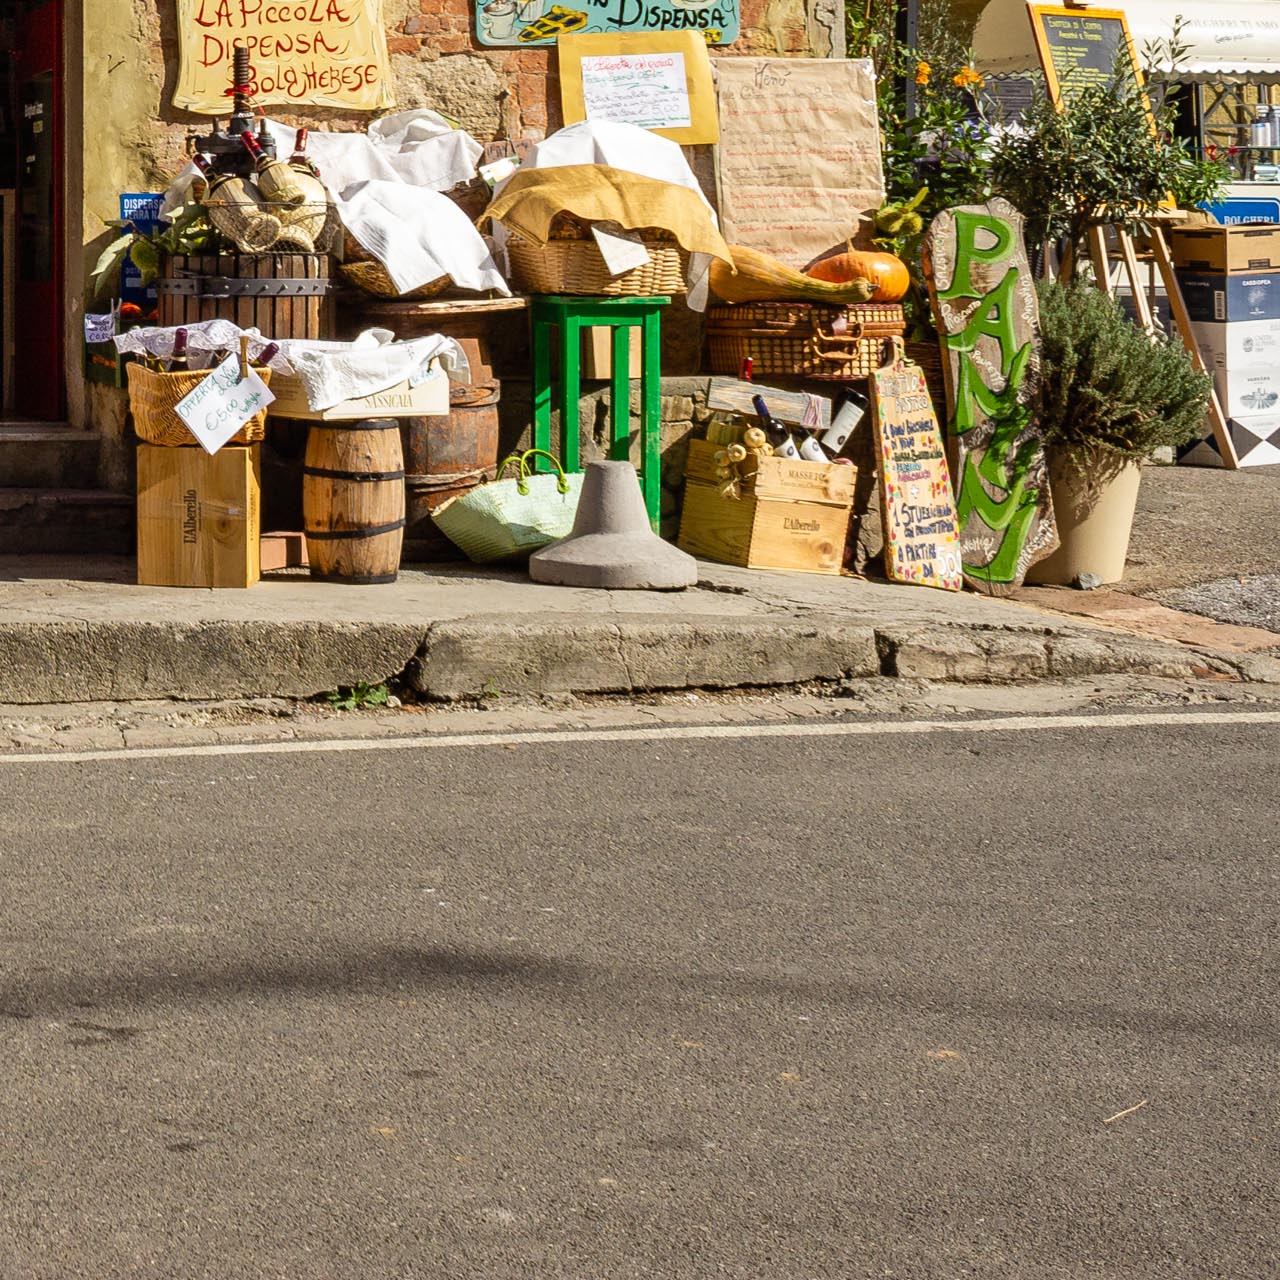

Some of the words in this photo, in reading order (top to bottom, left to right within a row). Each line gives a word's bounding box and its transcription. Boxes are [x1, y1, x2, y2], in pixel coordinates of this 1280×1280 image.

[200, 31, 341, 68] DISPENSA
[123, 209, 149, 220] TERRA
[178, 375, 219, 418] OFFERTA
[183, 489, 197, 544] L'Alberello
[783, 517, 821, 532] L'Alberello
[905, 543, 936, 562] PARTIRE
[922, 562, 933, 578] DA
